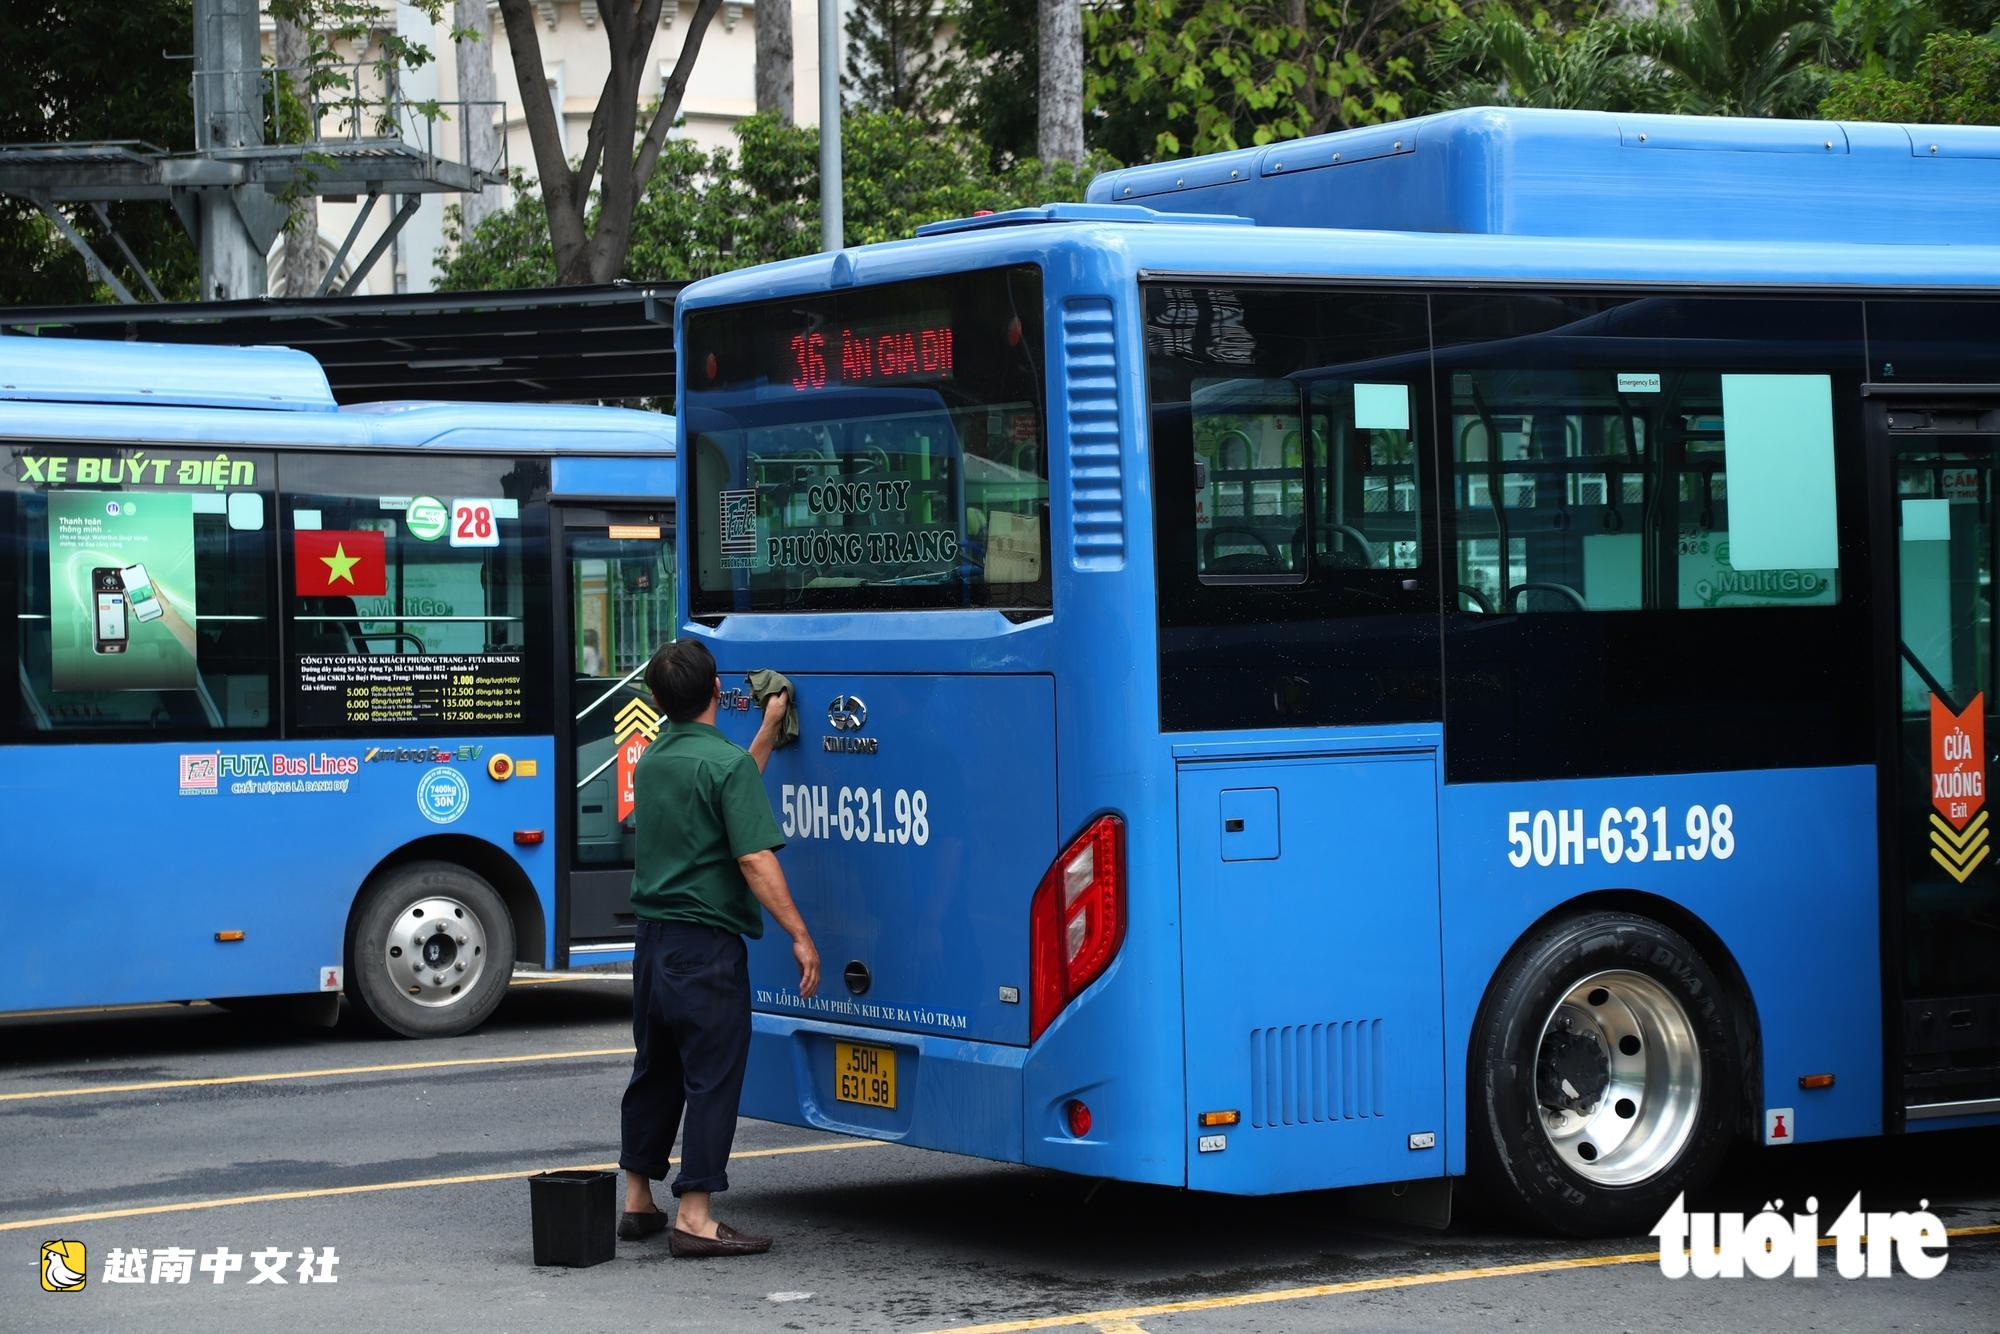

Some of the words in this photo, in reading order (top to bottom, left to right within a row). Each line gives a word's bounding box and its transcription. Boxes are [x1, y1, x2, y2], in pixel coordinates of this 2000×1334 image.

[791, 331, 826, 392] 36
[877, 332, 918, 376] GIA
[1619, 379, 1648, 387] Emergency
[20, 457, 68, 483] XE
[76, 452, 171, 484] BUÝT
[807, 475, 873, 515] CÔNG
[877, 480, 911, 512] TY
[59, 517, 83, 525] Thanh
[84, 517, 102, 526] toán
[59, 525, 81, 534] thông
[83, 525, 102, 533] minh
[456, 506, 492, 538] 28
[766, 529, 863, 567] PHƯƠNG
[868, 530, 959, 564] TRANG
[1718, 570, 1817, 592] MultiGo
[301, 656, 322, 665] CÔNG
[379, 656, 406, 664] KHÁCH
[407, 656, 438, 664] PHƯƠNG
[487, 656, 520, 664] BUSLINES
[384, 665, 394, 673] Tp.
[453, 675, 474, 685] 3.000
[346, 687, 369, 697] 5.000
[442, 687, 474, 696] 112.500
[346, 700, 370, 709] 6.000
[442, 699, 474, 708] 135.000
[346, 712, 370, 721] 7.000
[442, 712, 474, 720] 157.500
[822, 736, 844, 752] KIM
[846, 737, 878, 753] LONG
[1943, 726, 1972, 761] CỬA
[627, 741, 646, 764] CỬ
[220, 755, 269, 777] FUTA
[273, 754, 306, 775] Bus
[309, 753, 358, 774] Lines
[231, 780, 258, 794] CHẤT
[258, 781, 291, 795] LƯỢNG
[292, 779, 305, 792] LÀ
[305, 780, 333, 792] DANH
[334, 778, 349, 793] DỰ
[1934, 763, 1982, 798] XUỐNG
[430, 785, 457, 795] 7400kg
[434, 796, 454, 807] 30N
[782, 784, 929, 846] 50H-631.98
[1951, 803, 1968, 818] Exit
[1507, 803, 1735, 868] 50H-631.98
[757, 990, 772, 1003] XIN
[776, 988, 791, 1005] LỖI
[808, 995, 829, 1011] LÀM
[831, 997, 860, 1016] PHIỀN
[862, 1005, 880, 1018] KHI
[882, 1007, 895, 1020] XE
[897, 1009, 911, 1022] RA
[913, 1008, 934, 1025] VÀO
[936, 1014, 966, 1030] TRẠM
[852, 1049, 878, 1075] 50H
[841, 1075, 889, 1105] 631.98
